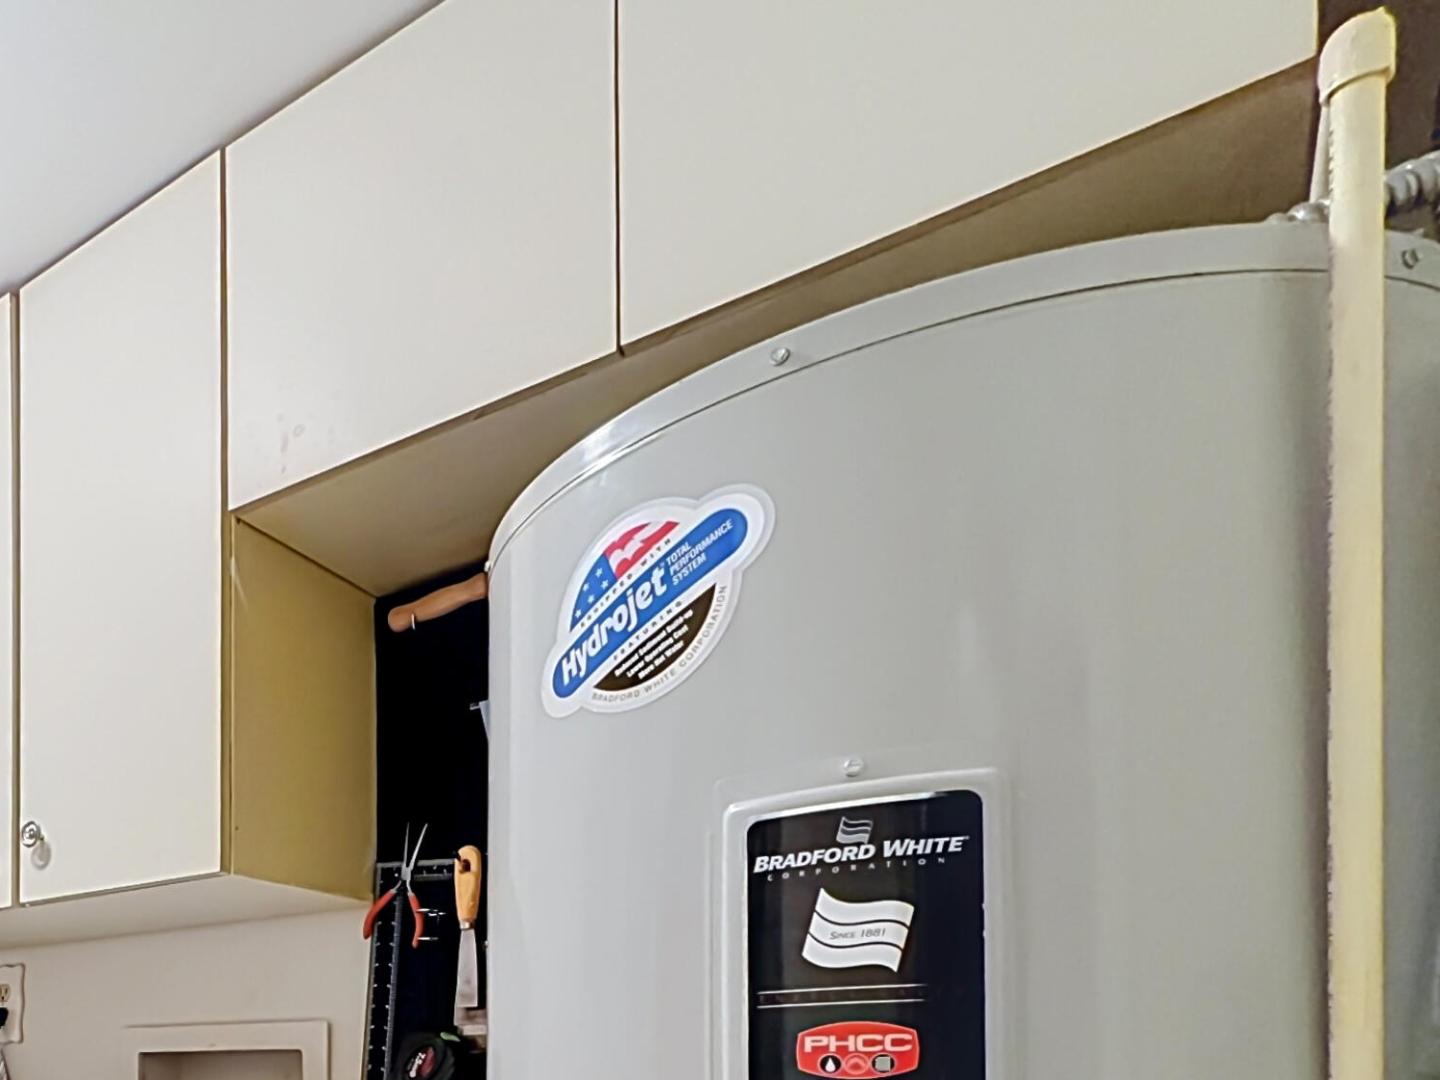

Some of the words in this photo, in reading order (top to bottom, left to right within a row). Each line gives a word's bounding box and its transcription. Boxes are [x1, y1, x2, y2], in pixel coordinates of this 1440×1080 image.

[666, 541, 692, 567] TOTAL
[669, 518, 734, 577] PERFORMANCE
[672, 553, 707, 587] SYSTEM
[561, 565, 667, 687] Hydrojet
[753, 843, 876, 873] BRADFORD
[882, 836, 965, 858] WHITE
[766, 857, 946, 882] CORPORATION
[803, 1033, 913, 1053] PHCC
